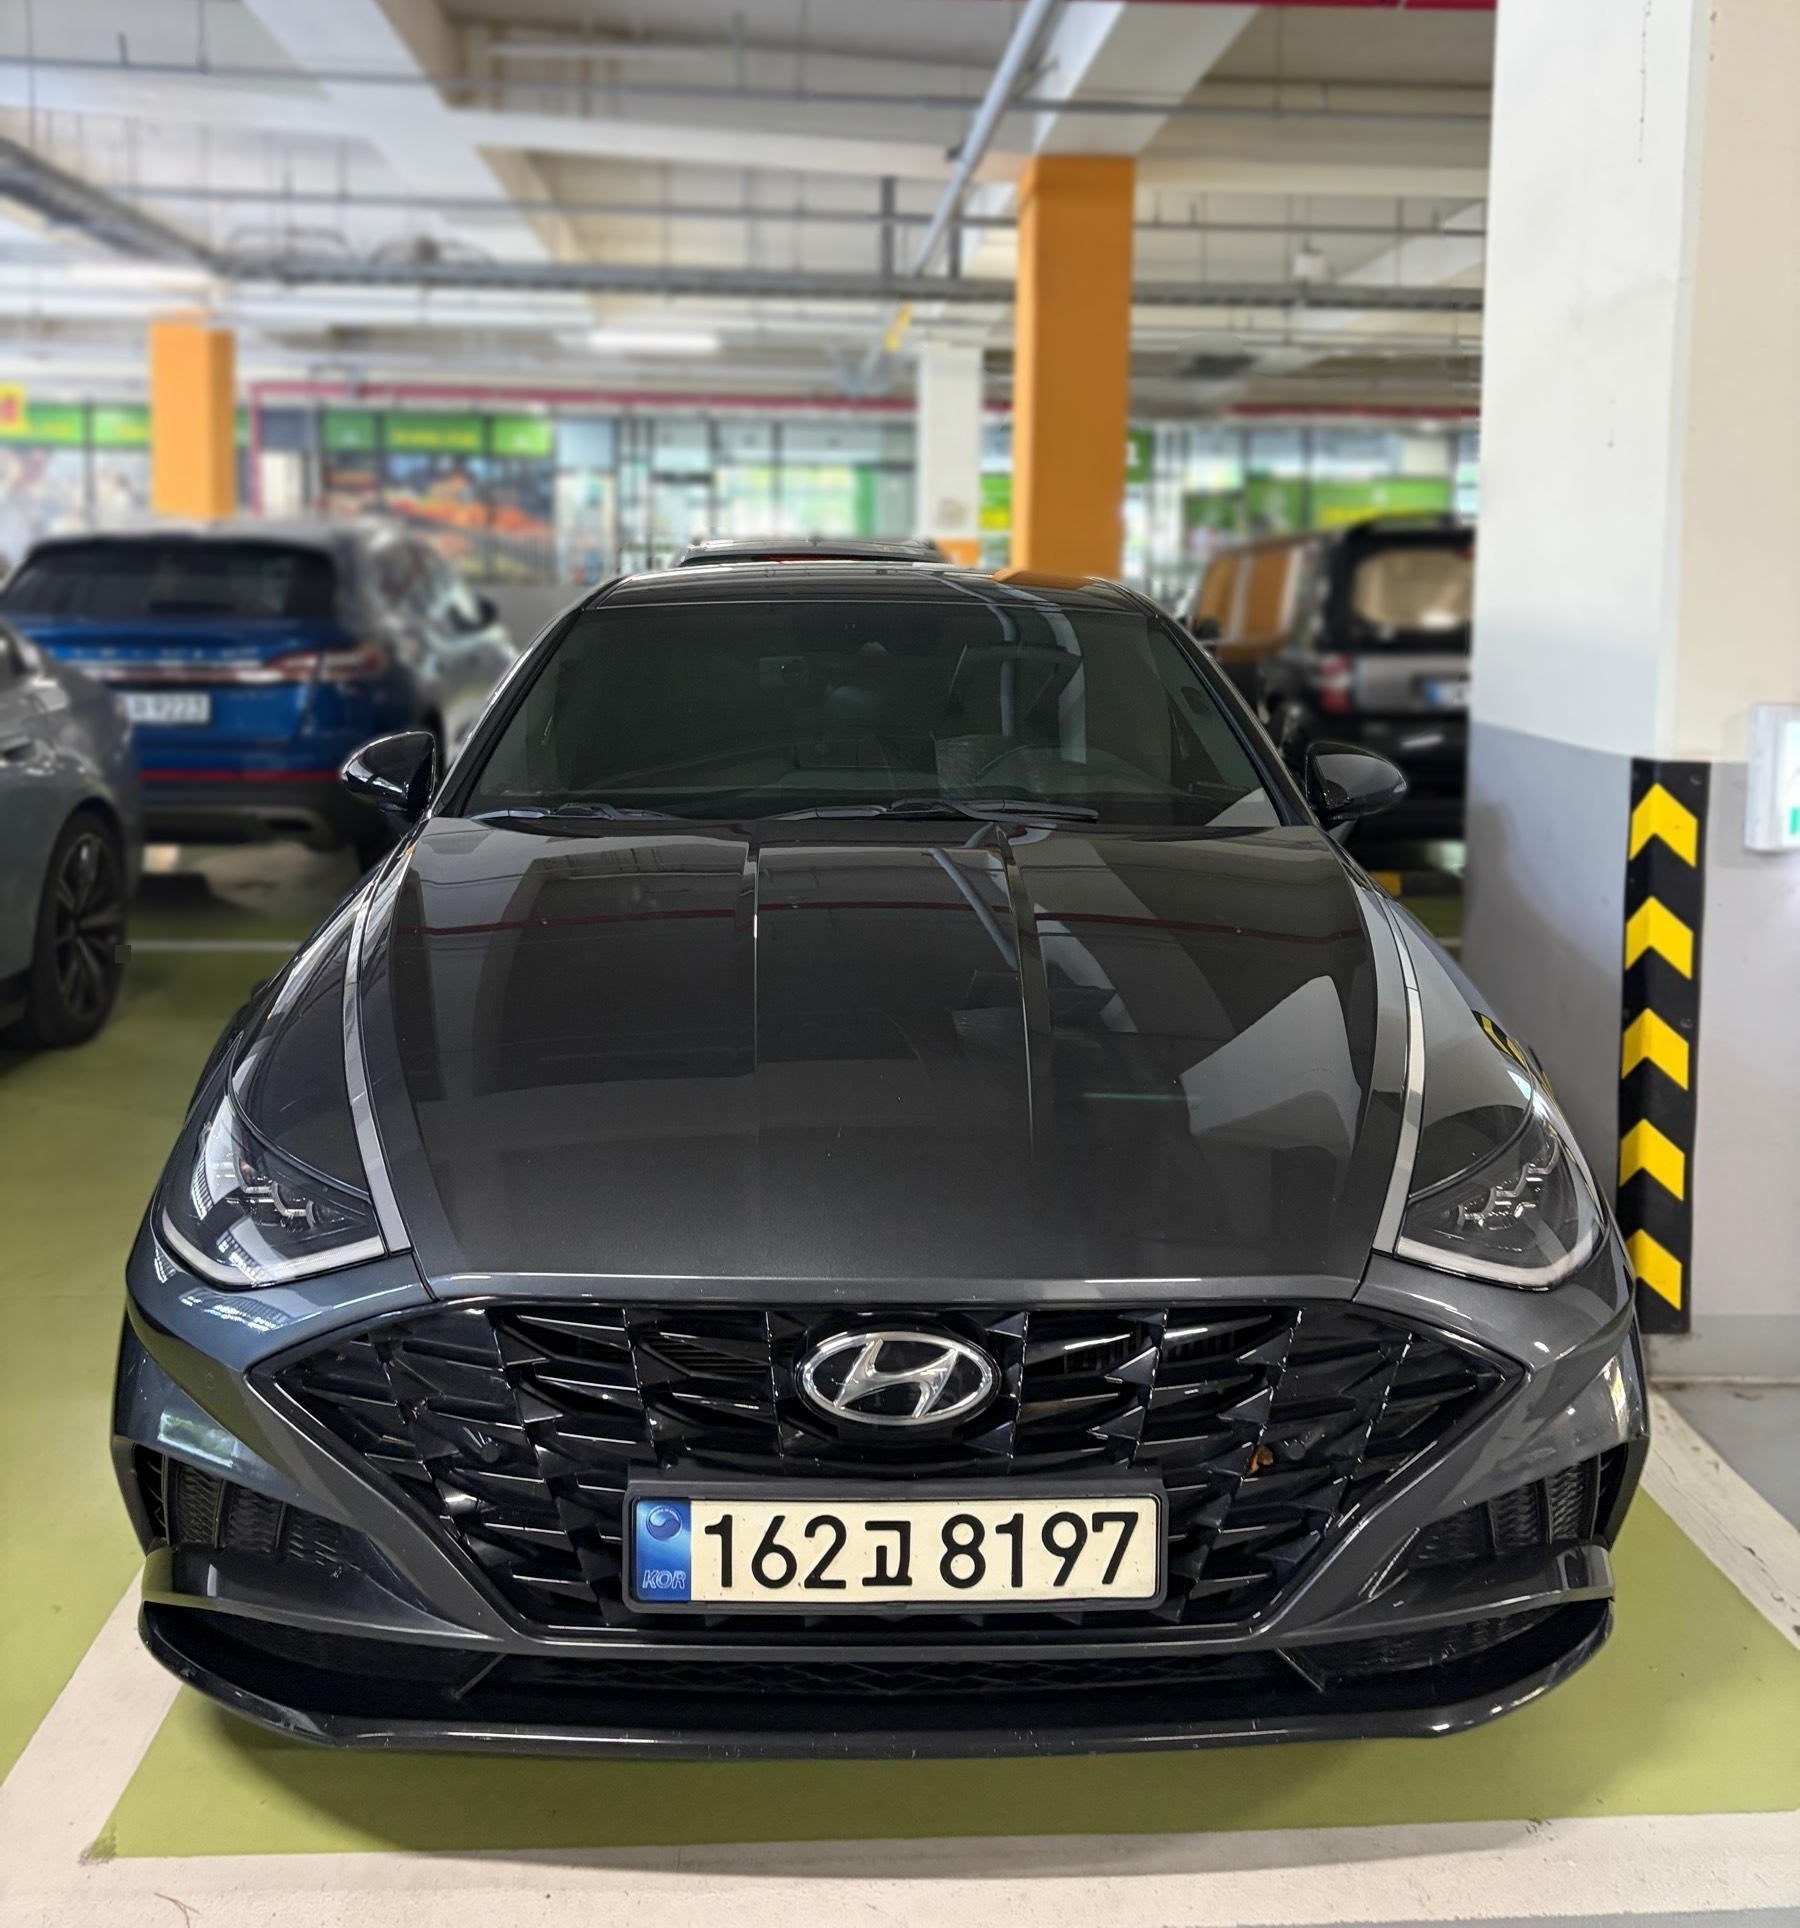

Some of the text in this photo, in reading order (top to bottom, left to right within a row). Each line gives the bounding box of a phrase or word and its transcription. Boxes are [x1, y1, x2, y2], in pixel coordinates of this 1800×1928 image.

[704, 1511, 1139, 1590] 162고 8197
[642, 1569, 687, 1590] KOR
